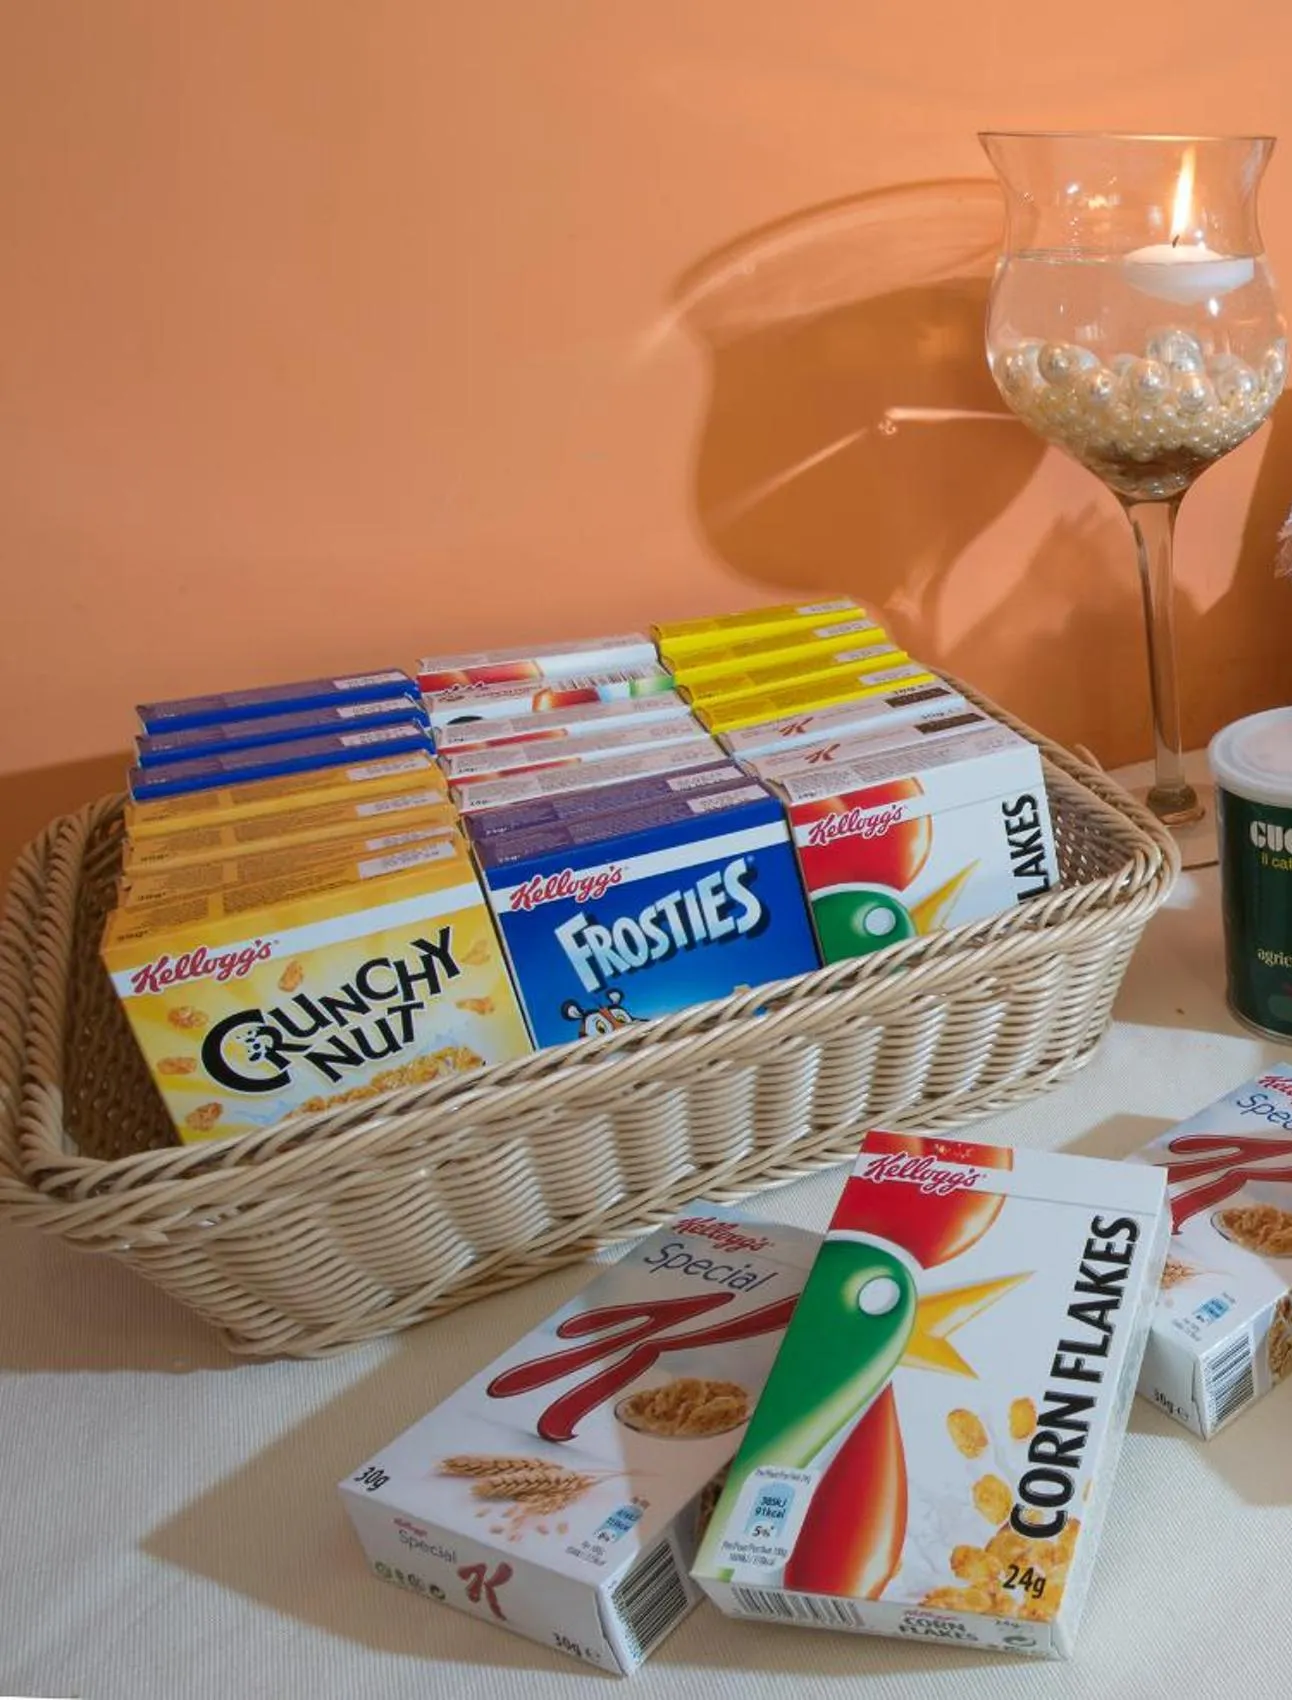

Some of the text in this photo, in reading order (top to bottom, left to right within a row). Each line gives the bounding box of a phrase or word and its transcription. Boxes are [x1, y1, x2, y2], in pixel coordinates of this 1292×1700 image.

[808, 802, 904, 846] Kellogg's
[1002, 793, 1051, 901] LAKES
[509, 866, 623, 910] Kellogg's
[554, 857, 763, 993] FROSTIES
[130, 939, 272, 994] Kellogg's
[201, 926, 461, 1092] CRUNCHY
[303, 1002, 424, 1083] NUT
[862, 1150, 984, 1194] Kellogg's
[671, 1216, 770, 1252] Kellogg's
[644, 1241, 779, 1293] Special
[487, 1291, 800, 1443] K
[1009, 1213, 1142, 1541] CORN FLAKES
[353, 1466, 391, 1492] 30g
[398, 1528, 458, 1564] Special
[456, 1561, 514, 1622] K
[1002, 1563, 1047, 1599] 24g
